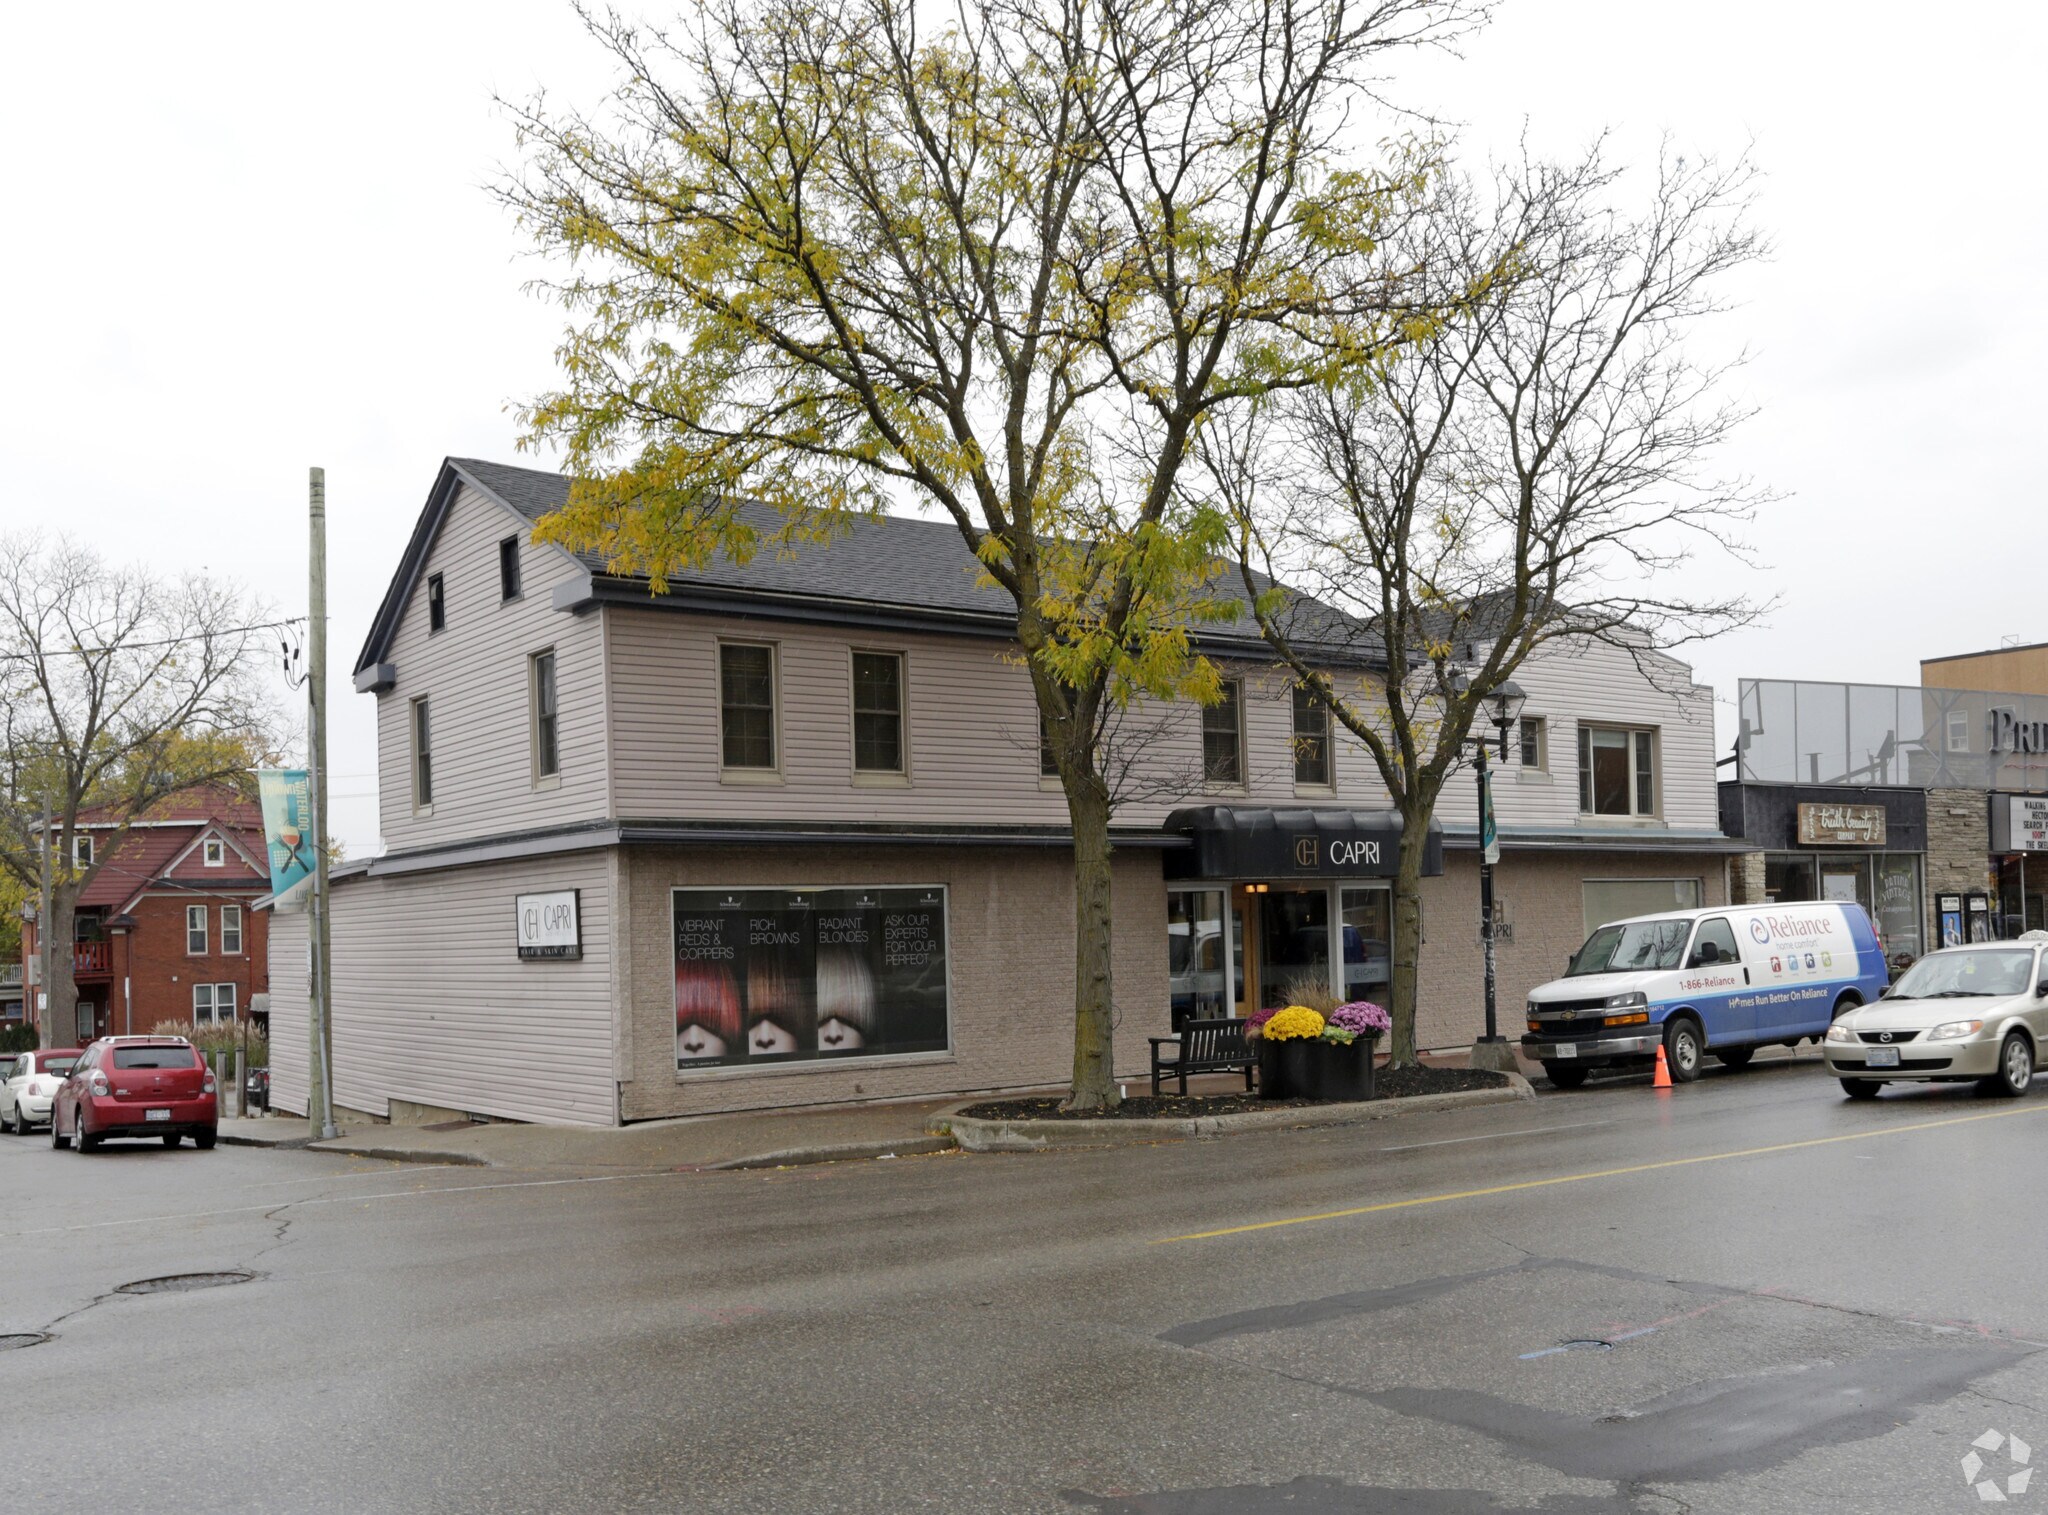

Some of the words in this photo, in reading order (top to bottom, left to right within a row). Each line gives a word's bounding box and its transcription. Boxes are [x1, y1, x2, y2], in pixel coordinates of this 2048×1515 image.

[1988, 708, 2048, 752] PRI
[294, 781, 309, 830] WATERLOO
[2024, 801, 2046, 810] WALKING
[1818, 806, 1846, 828] truth
[1846, 808, 1872, 840] beauty
[2024, 820, 2042, 829] SEARCH
[1838, 832, 1856, 840] COMPANY
[2026, 840, 2034, 848] THE
[1330, 840, 1380, 864] CAPRI
[544, 904, 572, 930] CAPRI
[884, 915, 905, 926] ASK
[907, 914, 929, 926] OUR
[678, 919, 725, 931] VIBRANT
[750, 919, 776, 931] RICH
[818, 918, 862, 929] RADIANT
[1766, 915, 1832, 938] Reliance
[679, 933, 710, 946] REDS
[714, 933, 721, 944] &
[750, 932, 800, 944] BROWNS
[819, 931, 868, 943] BLONDES
[885, 928, 928, 939] EXPERTS
[886, 941, 906, 952] FOR
[908, 940, 936, 952] YOUR
[1776, 942, 1793, 950] home
[1794, 938, 1817, 949] comfort
[679, 947, 734, 960] COPPERS
[886, 953, 929, 965] PERFECT
[1679, 976, 1735, 990] 1-866-Reliance
[1756, 996, 1768, 1005] Run
[1770, 992, 1790, 1004] Better
[1791, 992, 1801, 1000] On
[1801, 990, 1827, 998] Reliance
